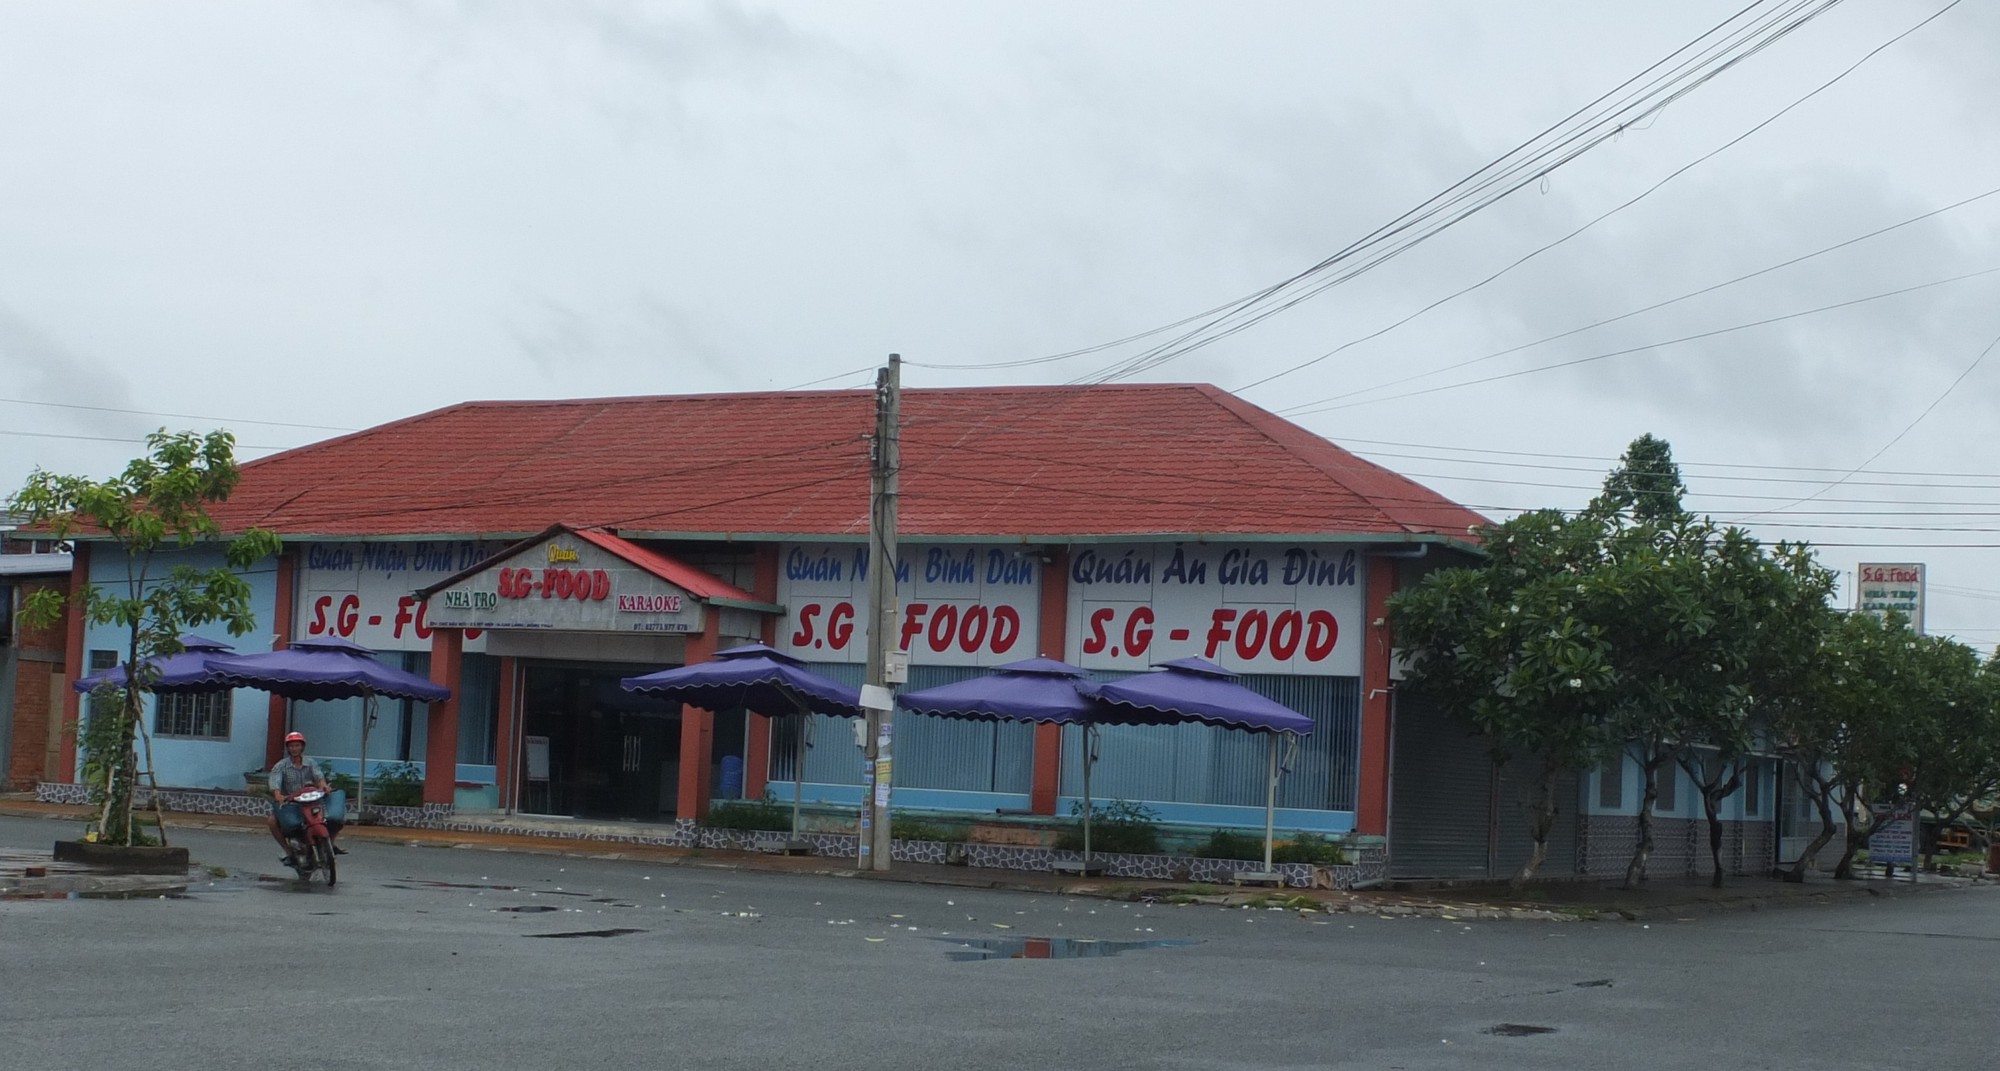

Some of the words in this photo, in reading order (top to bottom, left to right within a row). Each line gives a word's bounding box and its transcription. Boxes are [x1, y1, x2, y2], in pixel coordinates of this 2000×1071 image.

[786, 547, 841, 582] Quán
[925, 547, 976, 584] Bình
[1072, 550, 1151, 585] Quán
[1218, 548, 1269, 586] Gia
[1282, 548, 1356, 587] Đình
[309, 595, 360, 637] S.G
[445, 587, 471, 608] NHÀ
[474, 592, 497, 611] TRỌ
[618, 595, 680, 612] KARAOKE
[792, 602, 855, 650] S.G
[899, 603, 1020, 654] FOOD
[1083, 606, 1155, 657] S.G
[1205, 608, 1339, 662] FOOD
